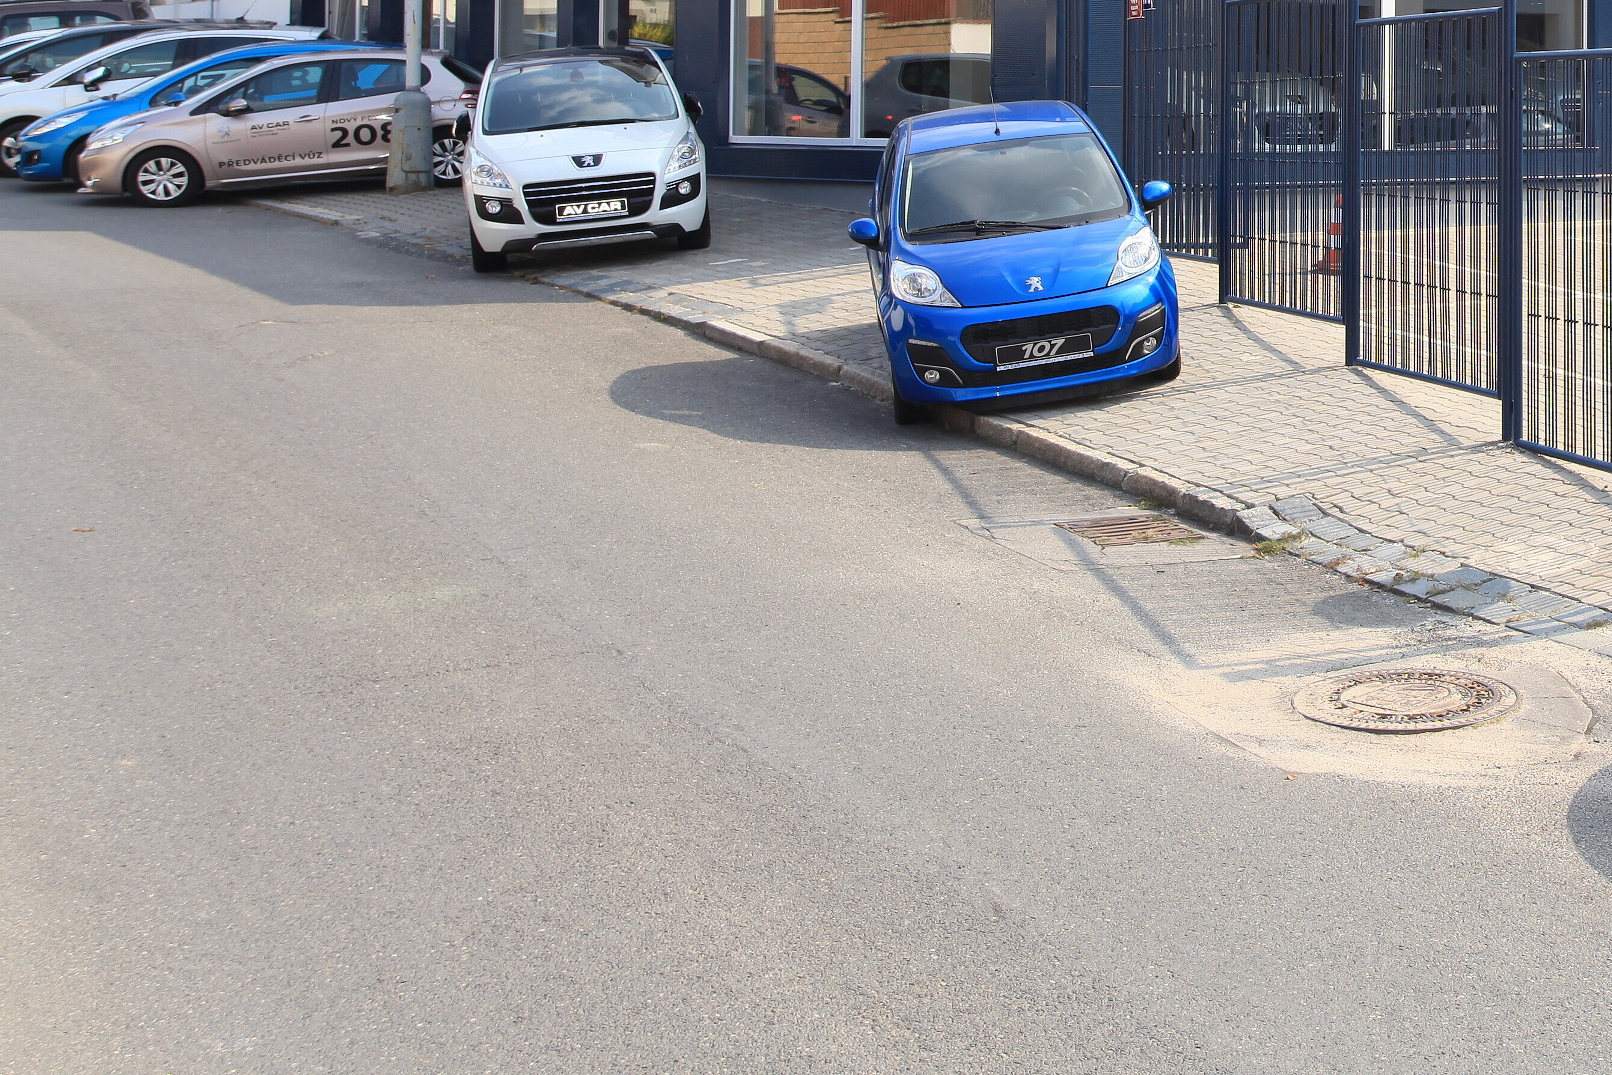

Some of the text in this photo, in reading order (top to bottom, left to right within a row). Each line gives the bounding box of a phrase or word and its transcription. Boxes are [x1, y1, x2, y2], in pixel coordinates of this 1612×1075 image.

[250, 123, 265, 132] AV
[266, 120, 290, 129] CAR
[331, 116, 358, 125] NOVÝ
[218, 150, 324, 169] PŘEDVÁDĚCÍ VŮZ
[563, 201, 622, 216] AV CAR
[1021, 338, 1066, 359] 107
